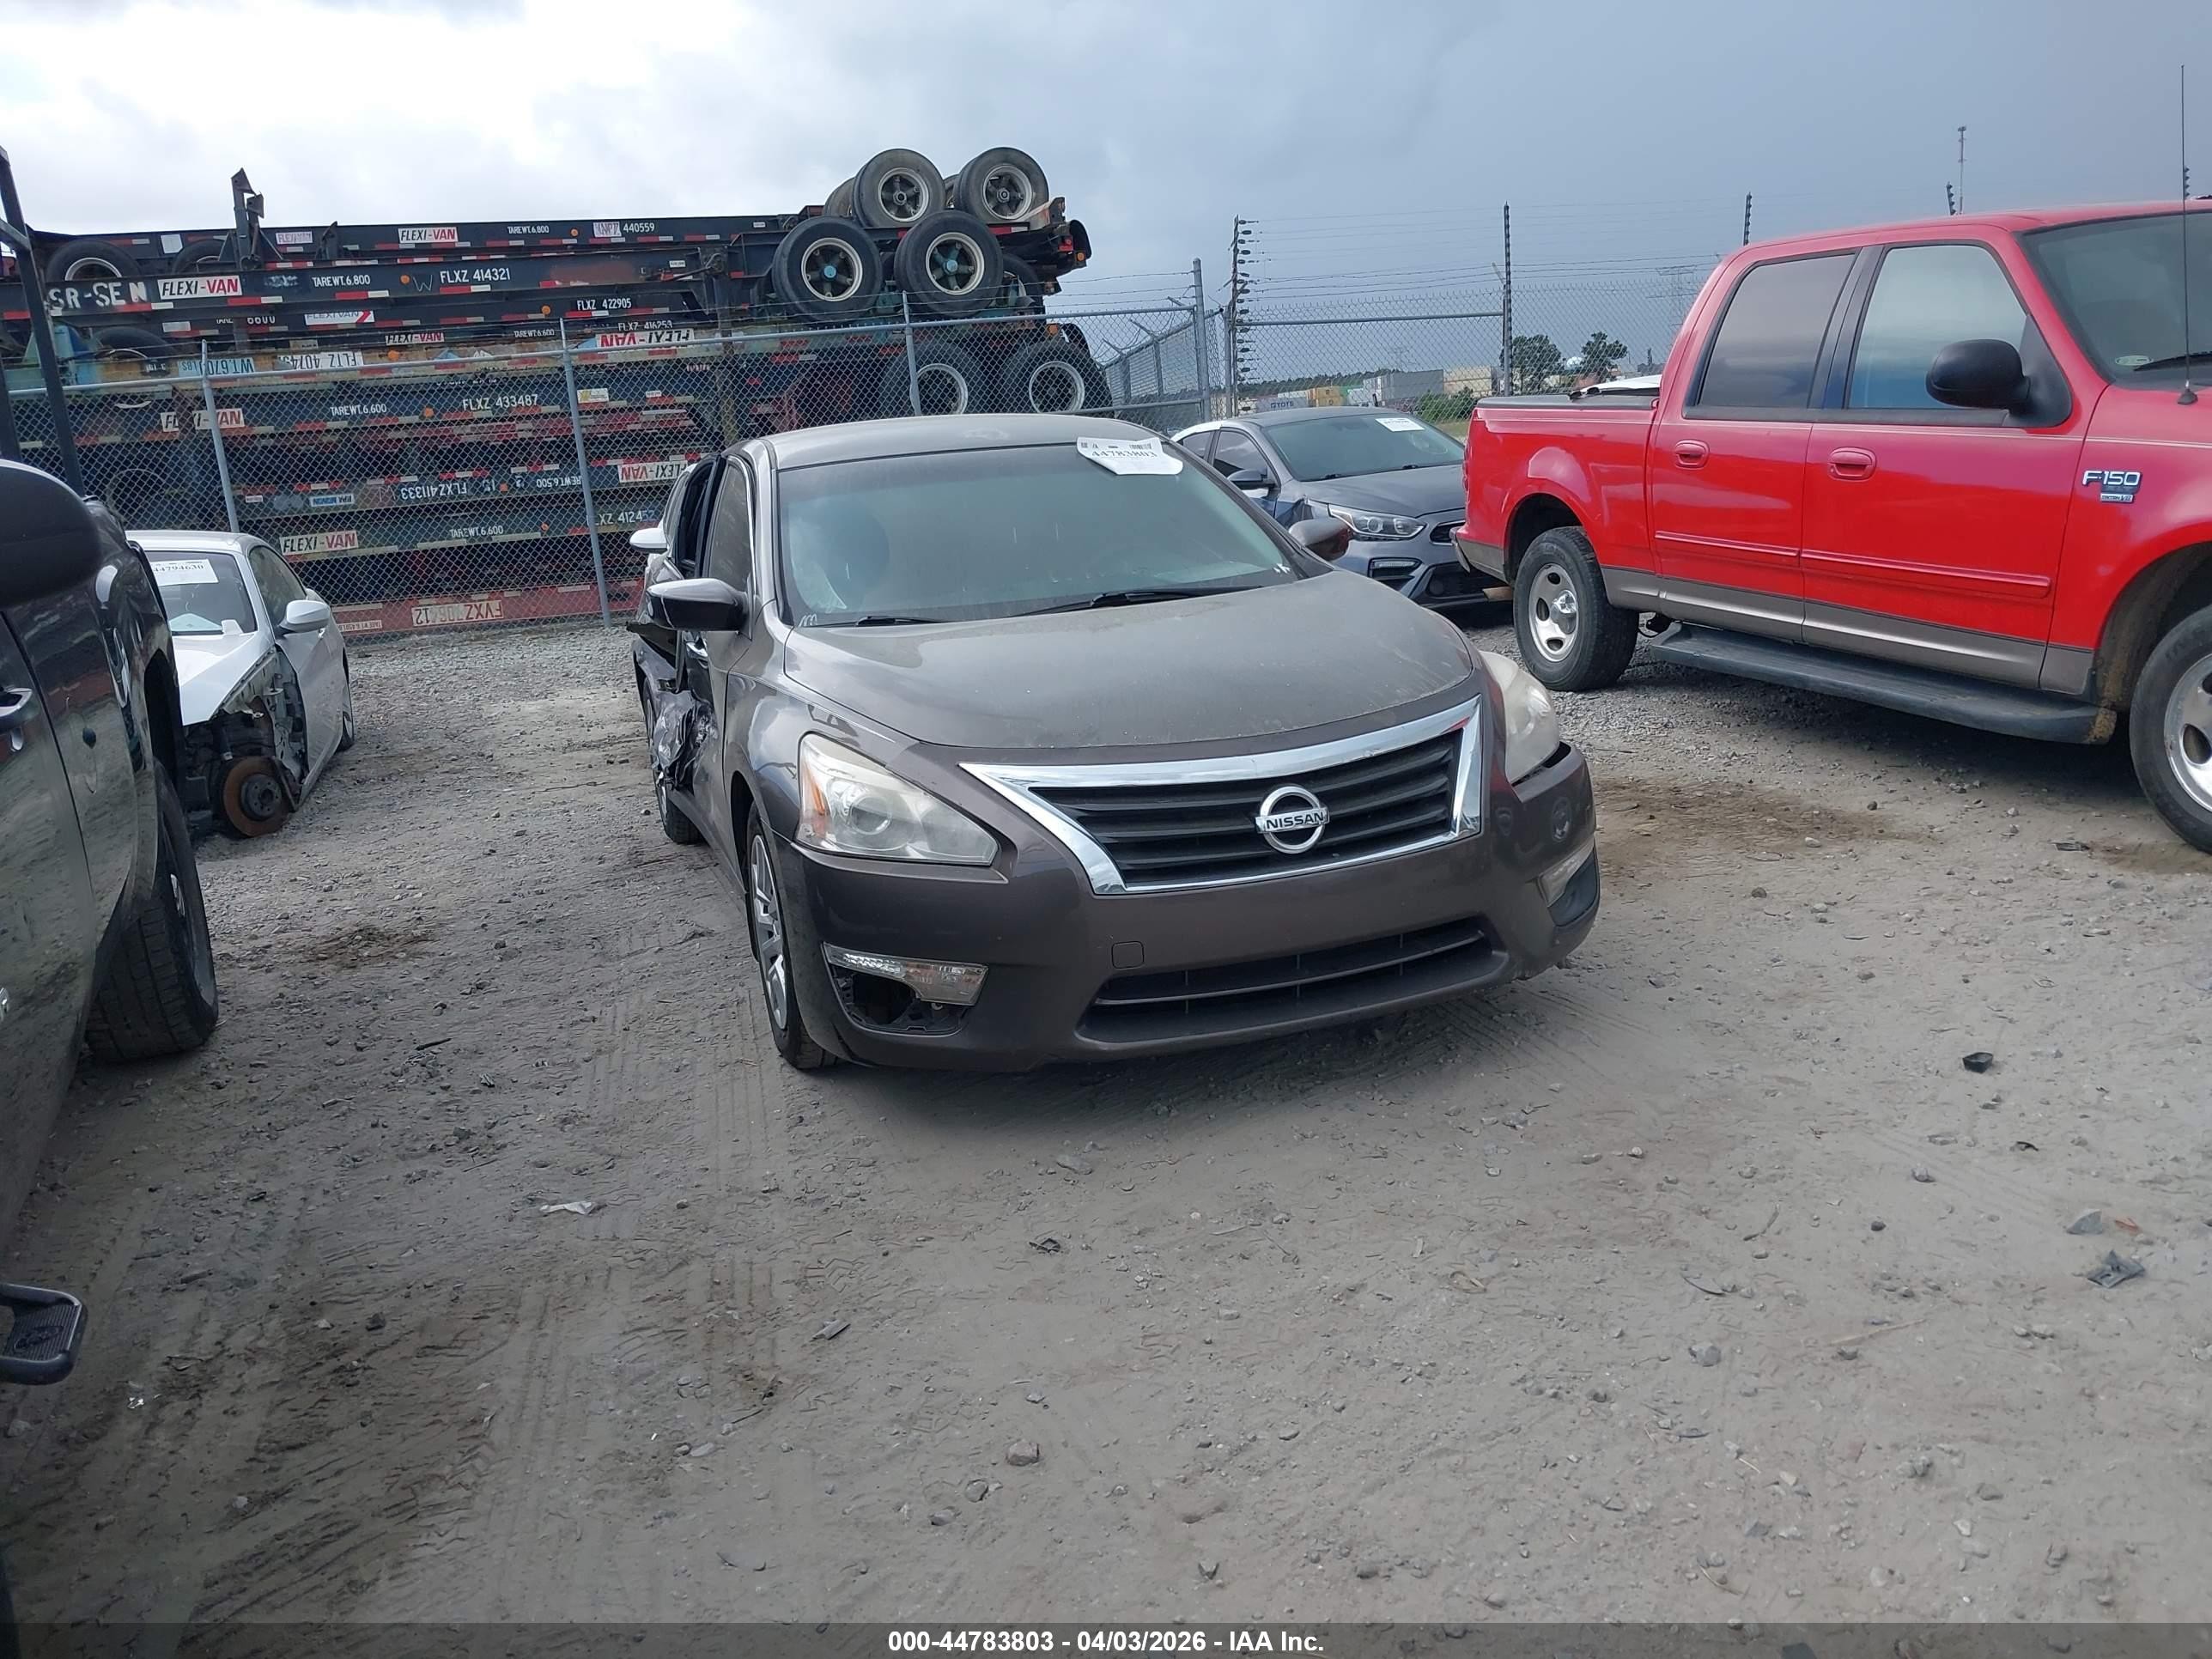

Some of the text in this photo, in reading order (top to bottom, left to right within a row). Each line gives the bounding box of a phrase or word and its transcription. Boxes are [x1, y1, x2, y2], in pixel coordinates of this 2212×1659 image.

[400, 228, 456, 241] FLEXI-VAN
[623, 222, 655, 233] 440559
[440, 268, 511, 283] FLXZ 414321
[161, 278, 239, 297] FLEXI-VAN
[577, 298, 632, 310] FLXZ 422905
[328, 353, 358, 368] FLTZ
[462, 393, 538, 411] FLXZ 433487
[2081, 470, 2141, 486] F-150
[283, 533, 356, 552] FLEXI-VAN
[464, 602, 502, 620] FVXZ
[1266, 811, 1323, 830] NISSAN
